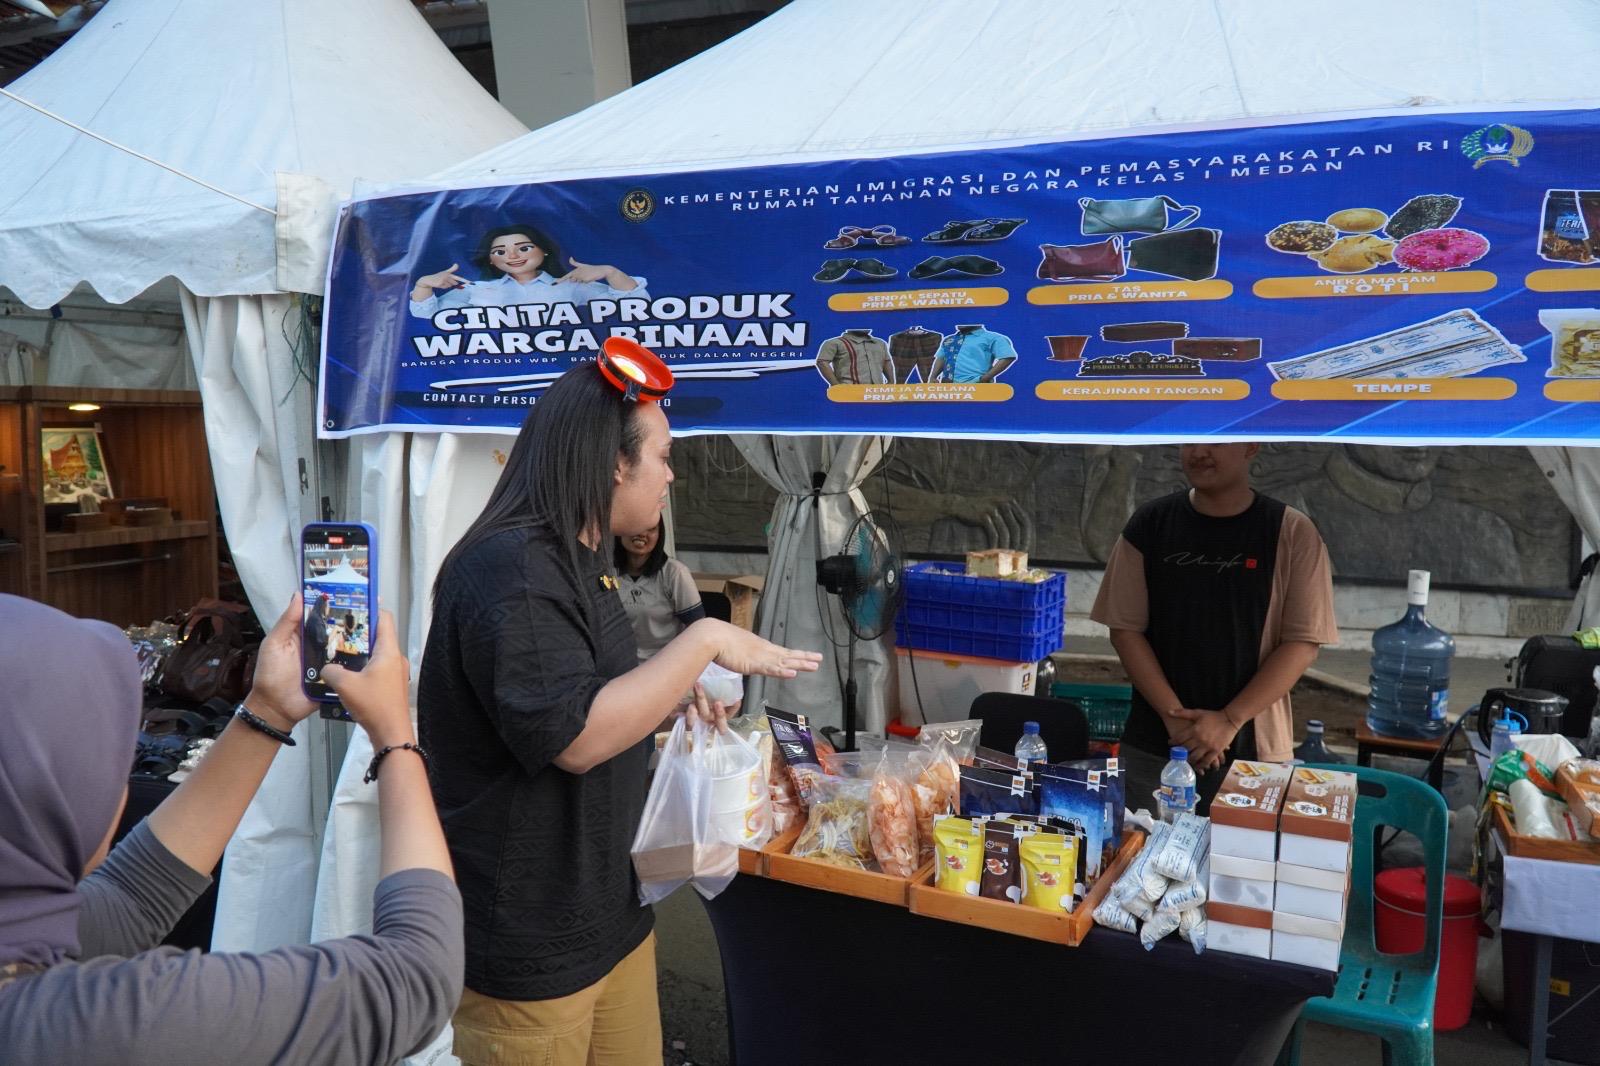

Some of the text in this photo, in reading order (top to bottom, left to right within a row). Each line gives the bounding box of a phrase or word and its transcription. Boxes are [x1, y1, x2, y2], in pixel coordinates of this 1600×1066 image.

[664, 184, 839, 205] KEMENTERIAN
[856, 173, 984, 192] IMIGRASI
[1003, 168, 1060, 181] DAN
[1081, 143, 1393, 175] PEMASYARAKATAN
[1417, 139, 1449, 152] RI
[732, 161, 1342, 211] RUMAH TAHANAN NEGARA KELAS I MEDAN
[1314, 275, 1436, 286] ANEKA MACAM
[1113, 285, 1141, 293] TAS
[1333, 283, 1409, 293] ROTI
[867, 291, 967, 302] SENDAL SEPATU
[1068, 293, 1103, 301] PRIA
[1121, 290, 1188, 299] WANITA
[862, 301, 895, 309] PRIA
[912, 297, 975, 306] WANITA
[433, 293, 793, 331] CINTA PRODUK
[412, 322, 807, 358] WARGA BINAAN
[401, 359, 456, 368] BANGGA
[1062, 387, 1150, 395] KERAJINAN
[1353, 383, 1432, 393] TEMPE
[423, 393, 536, 405] CONTACT PERSO
[863, 393, 896, 401] PRIA
[912, 392, 975, 400] WANITA
